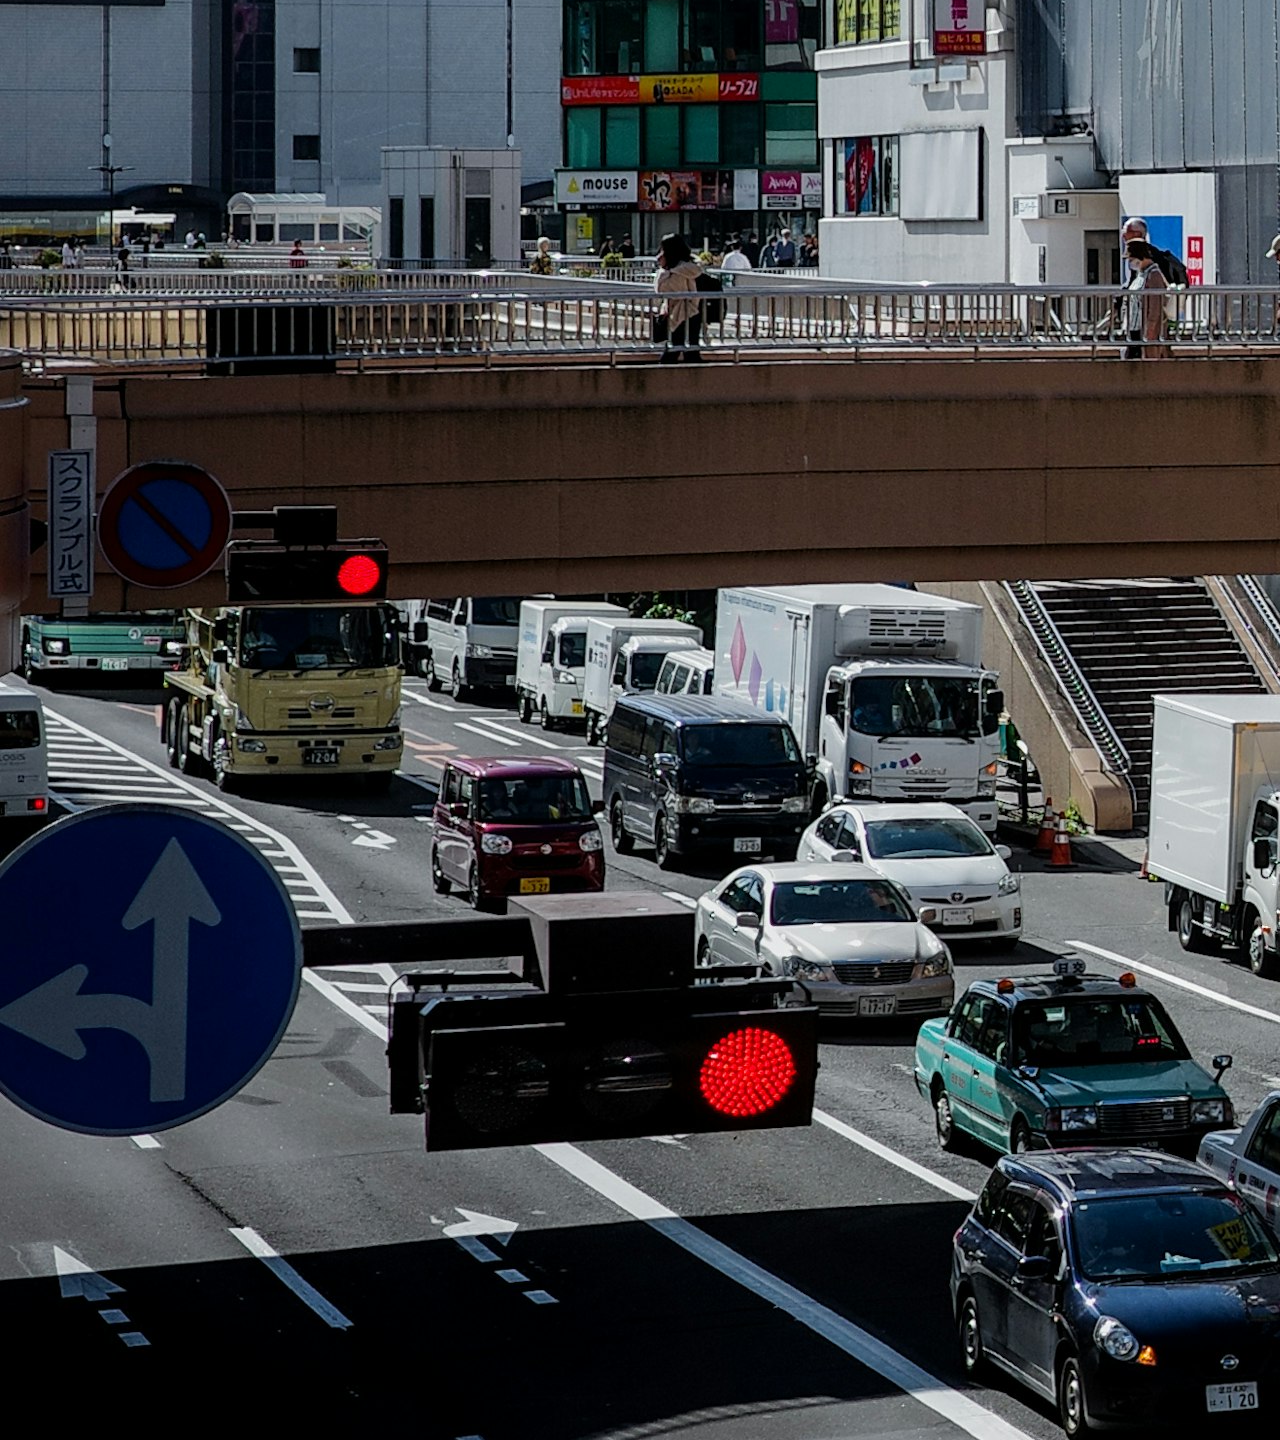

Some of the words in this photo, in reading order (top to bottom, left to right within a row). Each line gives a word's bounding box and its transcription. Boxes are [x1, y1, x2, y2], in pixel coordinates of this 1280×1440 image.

[719, 79, 758, 96] リーブ21
[582, 175, 628, 190] mouse
[58, 456, 84, 591] スクランブル式
[1059, 961, 1085, 972] 日交
